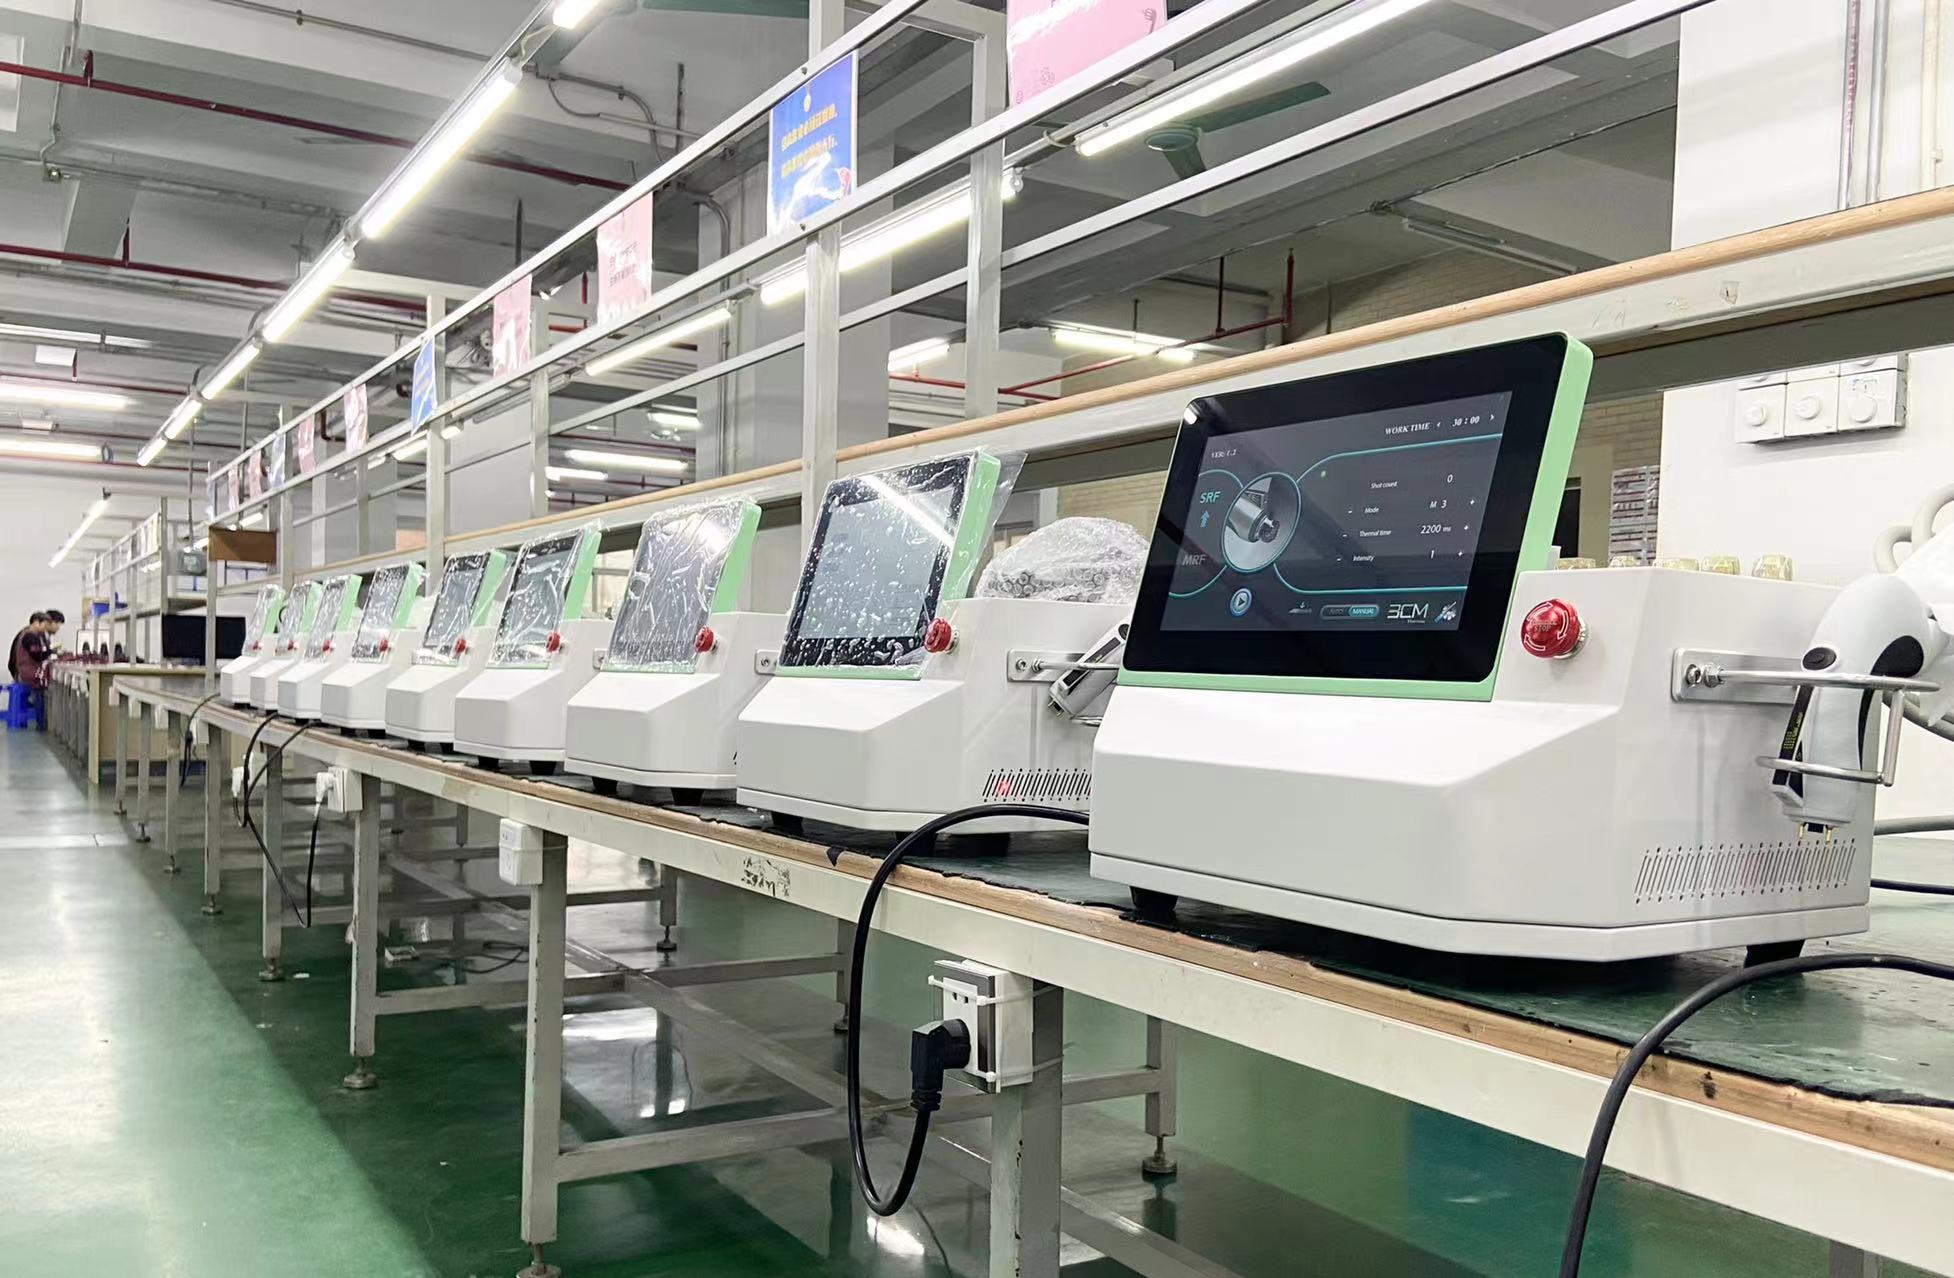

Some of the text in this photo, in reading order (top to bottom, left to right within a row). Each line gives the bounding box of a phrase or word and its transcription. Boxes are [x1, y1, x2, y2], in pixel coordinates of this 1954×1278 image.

[1385, 426, 1408, 434] WORK
[1410, 422, 1430, 431] TIME
[1452, 418, 1462, 427] 30
[1469, 415, 1480, 424] 00
[1447, 474, 1453, 483] 0
[1199, 490, 1221, 504] SRF
[1420, 524, 1441, 534] 2200
[1182, 554, 1206, 566] MRF
[1353, 554, 1375, 562] Intensity
[1387, 603, 1429, 619] 3CM
